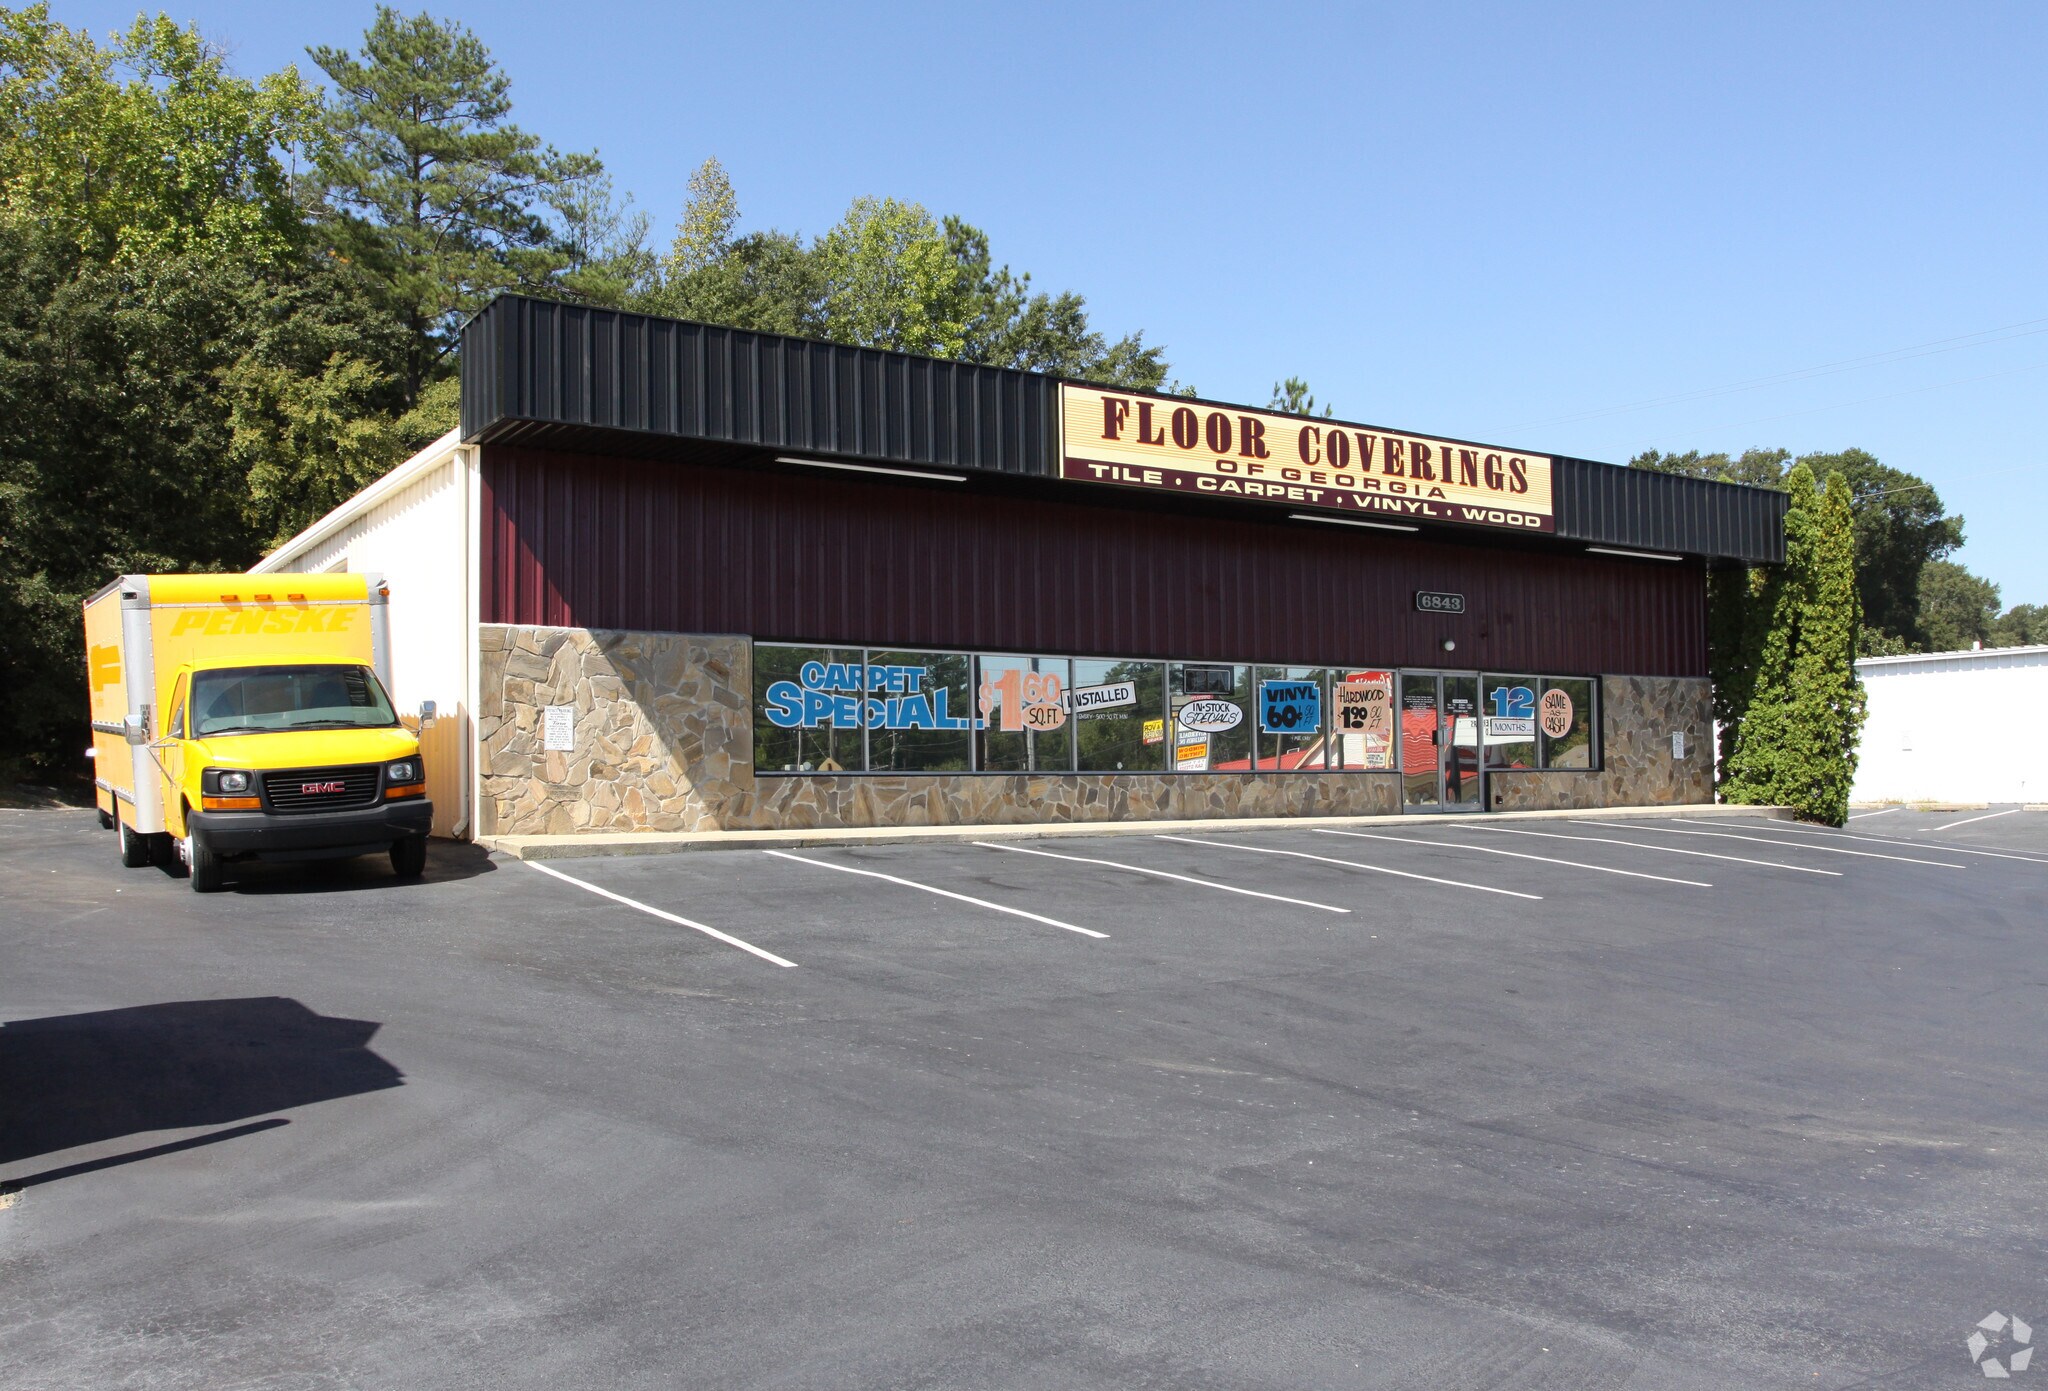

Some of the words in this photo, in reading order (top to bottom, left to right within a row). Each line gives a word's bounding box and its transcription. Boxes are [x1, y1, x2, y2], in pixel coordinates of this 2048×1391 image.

[1101, 396, 1270, 459] FLOOR
[1298, 425, 1529, 494] COVERINGS
[1215, 459, 1264, 476] OF
[1281, 467, 1447, 500] GEORGIA
[1088, 463, 1163, 485] TILE
[1196, 476, 1324, 501] CARPET
[1352, 494, 1437, 516] VINYL
[1461, 507, 1541, 528] WOOD
[1422, 595, 1461, 610] 6843
[170, 607, 358, 637] PENSKE
[800, 660, 927, 694] CARPET
[1067, 687, 1129, 709] INSTALLED
[1266, 686, 1317, 703] VINYL
[1338, 686, 1384, 703] HARDWOOD
[1490, 686, 1535, 718] 12
[1545, 693, 1566, 710] SAME
[1184, 711, 1240, 725] SPECIALS
[1550, 709, 1561, 717] AS
[1545, 715, 1566, 733] CASH
[302, 781, 345, 794] GMC
